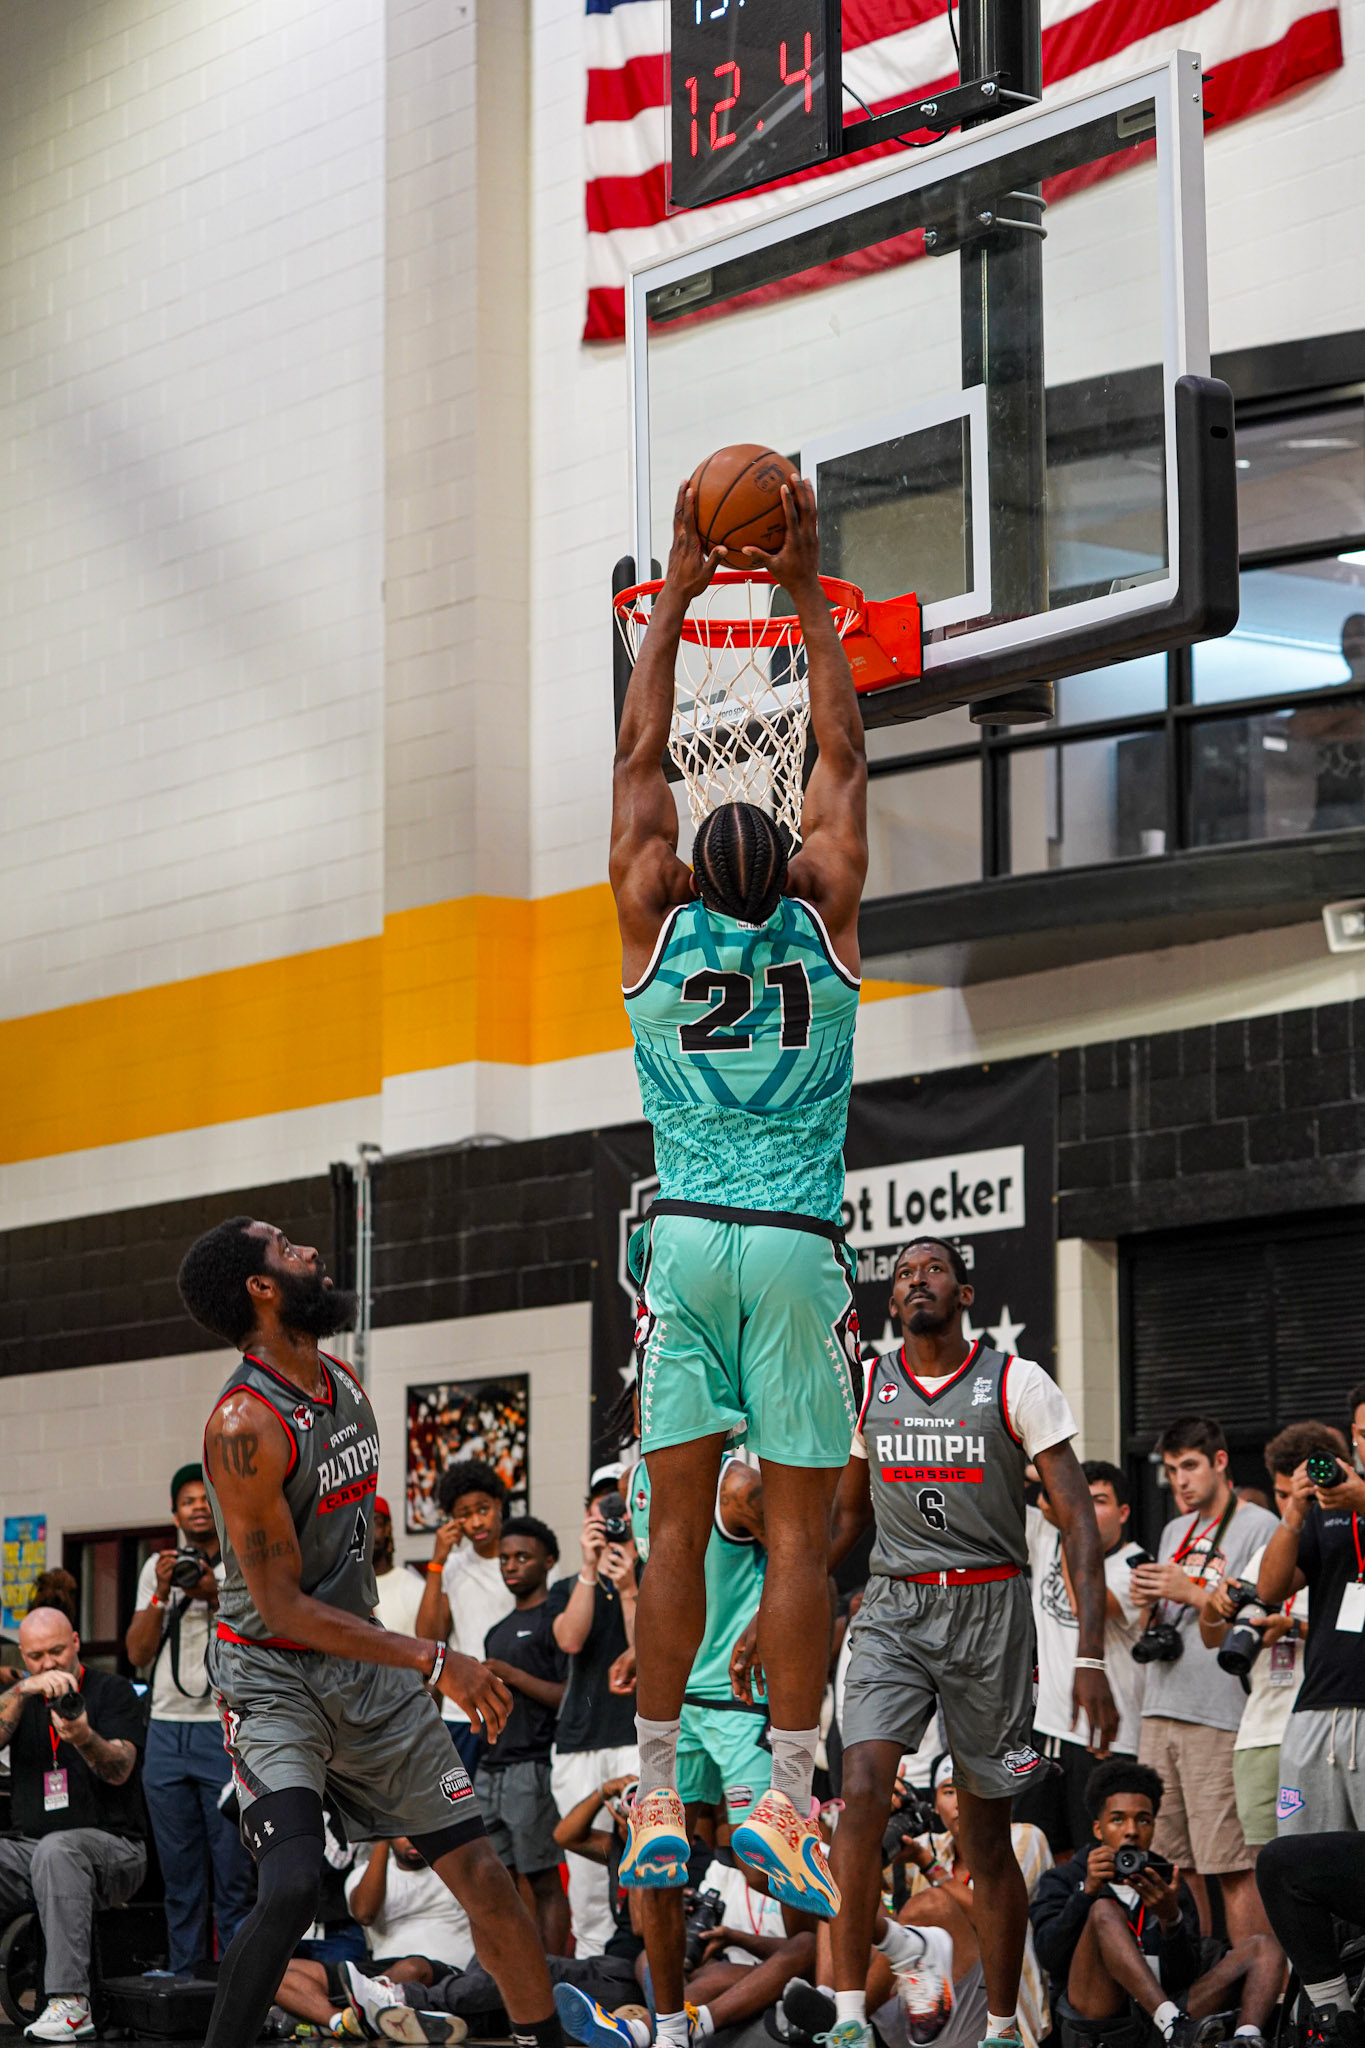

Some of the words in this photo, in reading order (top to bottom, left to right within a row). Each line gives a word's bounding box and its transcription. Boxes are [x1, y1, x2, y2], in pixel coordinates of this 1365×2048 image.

[676, 958, 813, 1054] 21
[841, 1186, 873, 1233] ot
[888, 1169, 1012, 1228] Locker
[904, 1417, 955, 1429] DANNY
[317, 1433, 380, 1497] RUMPH
[876, 1435, 986, 1463] RUMPH
[894, 1469, 966, 1480] CLASSIC
[916, 1488, 948, 1531] 6
